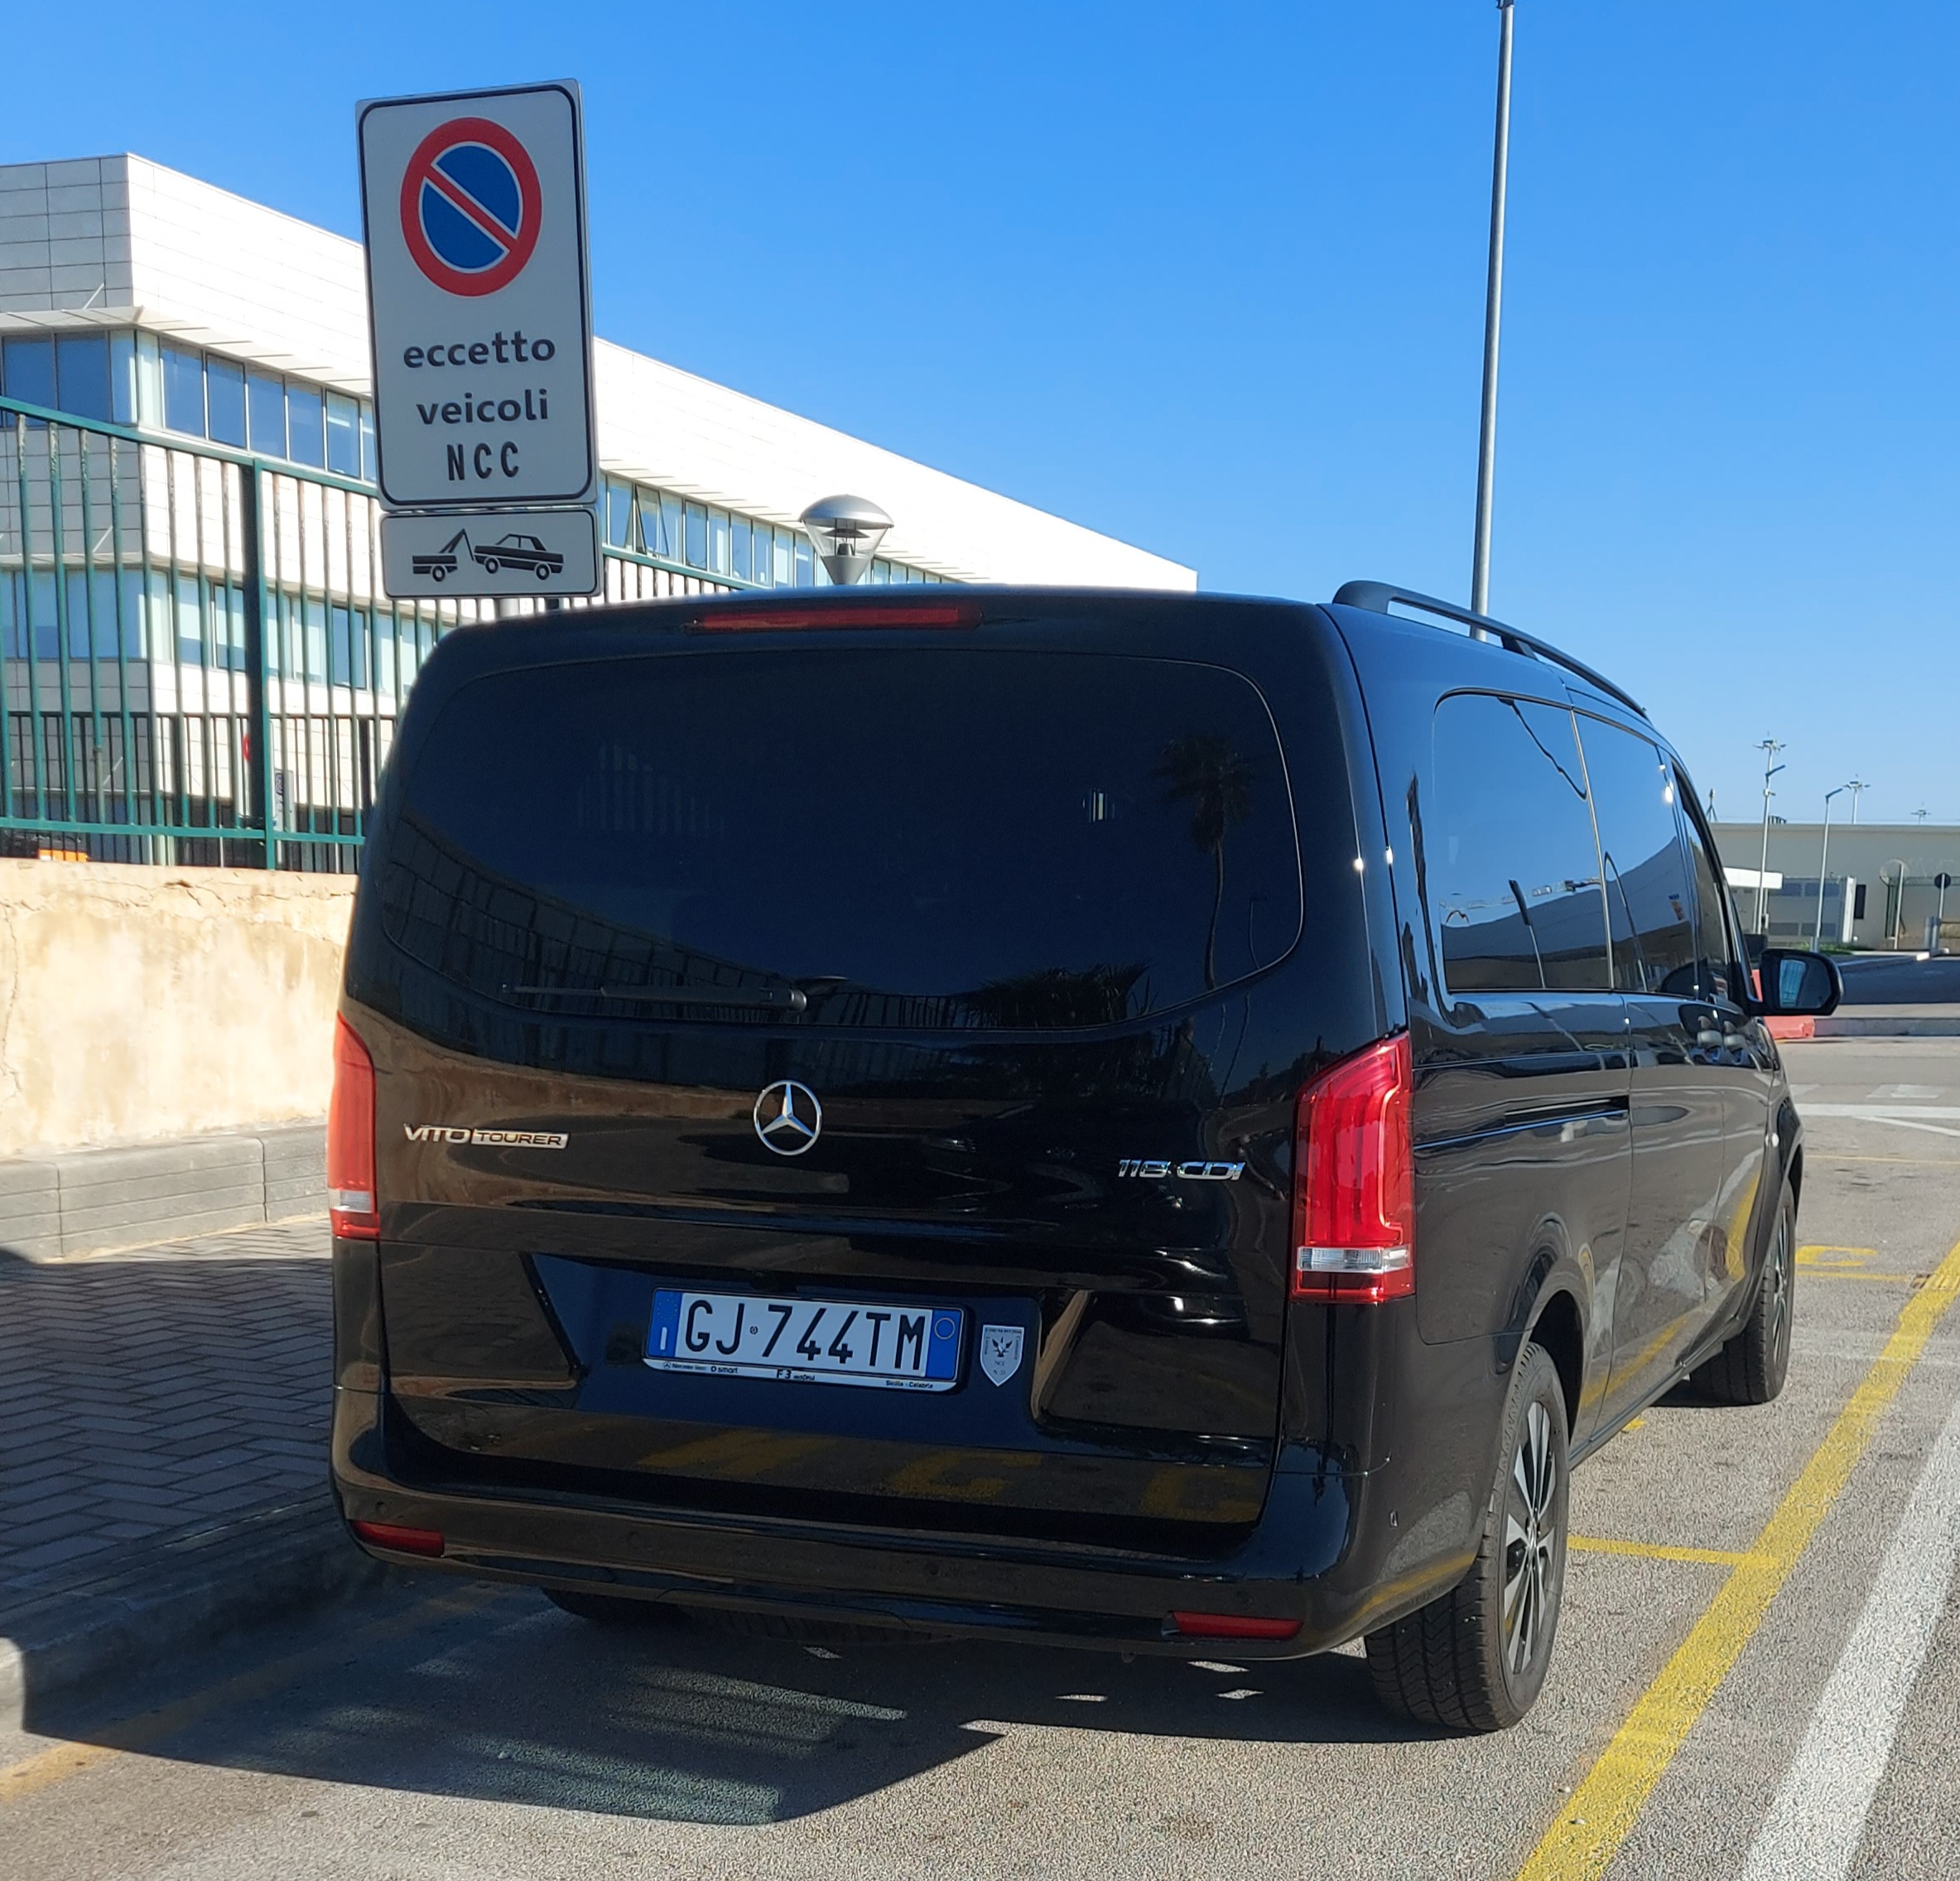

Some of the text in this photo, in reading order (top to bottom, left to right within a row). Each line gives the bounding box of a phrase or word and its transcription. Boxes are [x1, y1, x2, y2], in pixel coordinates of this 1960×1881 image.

[403, 330, 556, 369] eccetto
[416, 388, 549, 426] veicoli
[446, 441, 519, 481] NCC
[403, 1123, 563, 1146] VITO TOURER
[1118, 1160, 1246, 1181] 118 CDI
